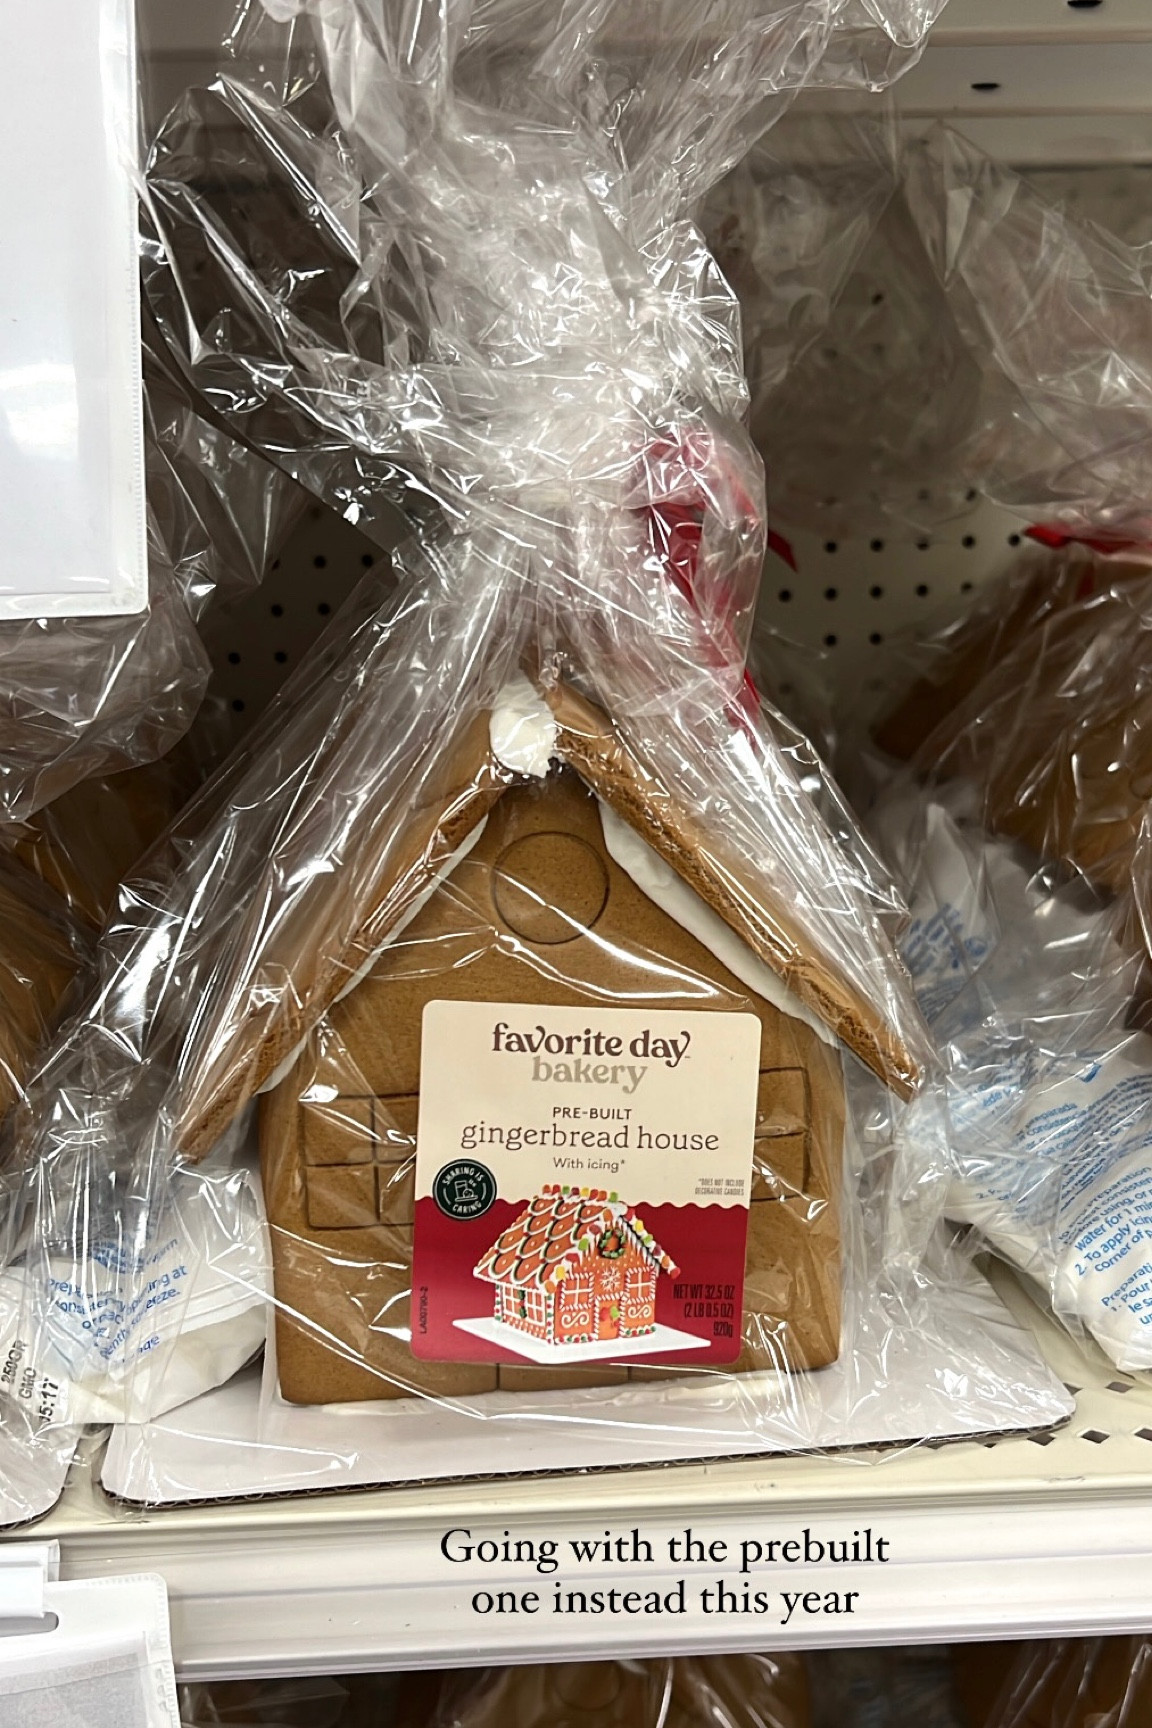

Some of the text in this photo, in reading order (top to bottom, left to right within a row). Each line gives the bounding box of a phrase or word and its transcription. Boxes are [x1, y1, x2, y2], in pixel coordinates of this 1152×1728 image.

[492, 1022, 691, 1068] favorite day
[532, 1056, 648, 1094] bakery
[552, 1106, 633, 1120] PRE-BUILT
[460, 1120, 720, 1151] gingerbread house
[553, 1157, 584, 1170] With
[1083, 1250, 1102, 1262] To
[1100, 1223, 1132, 1254] apply
[1094, 1242, 1132, 1272] corner
[172, 1263, 188, 1280] at
[673, 1284, 688, 1299] NET
[689, 1284, 703, 1299] WT
